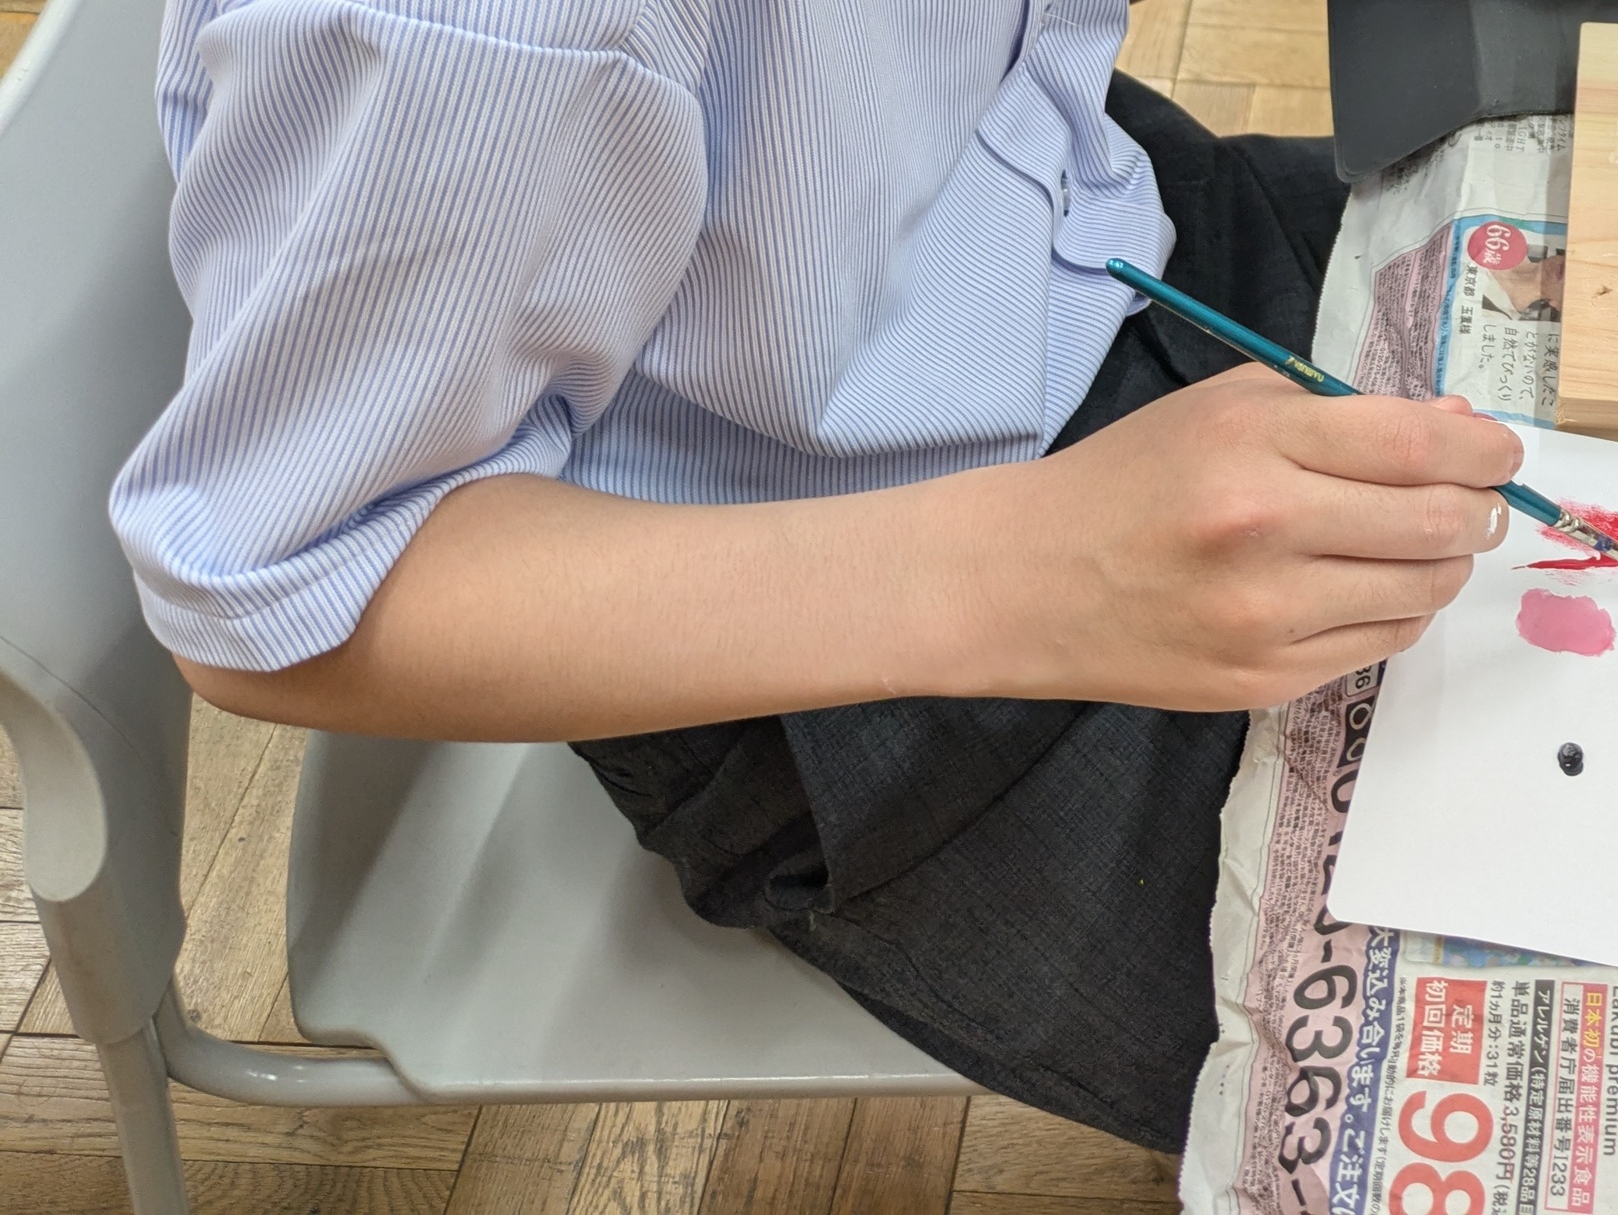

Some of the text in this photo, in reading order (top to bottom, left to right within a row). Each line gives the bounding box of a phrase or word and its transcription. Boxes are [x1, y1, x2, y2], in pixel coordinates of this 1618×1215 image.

[1485, 223, 1511, 266] 66歳
[1463, 265, 1478, 296] 東京都
[1416, 978, 1449, 1078] 初回価格
[1450, 1003, 1475, 1055] 定期
